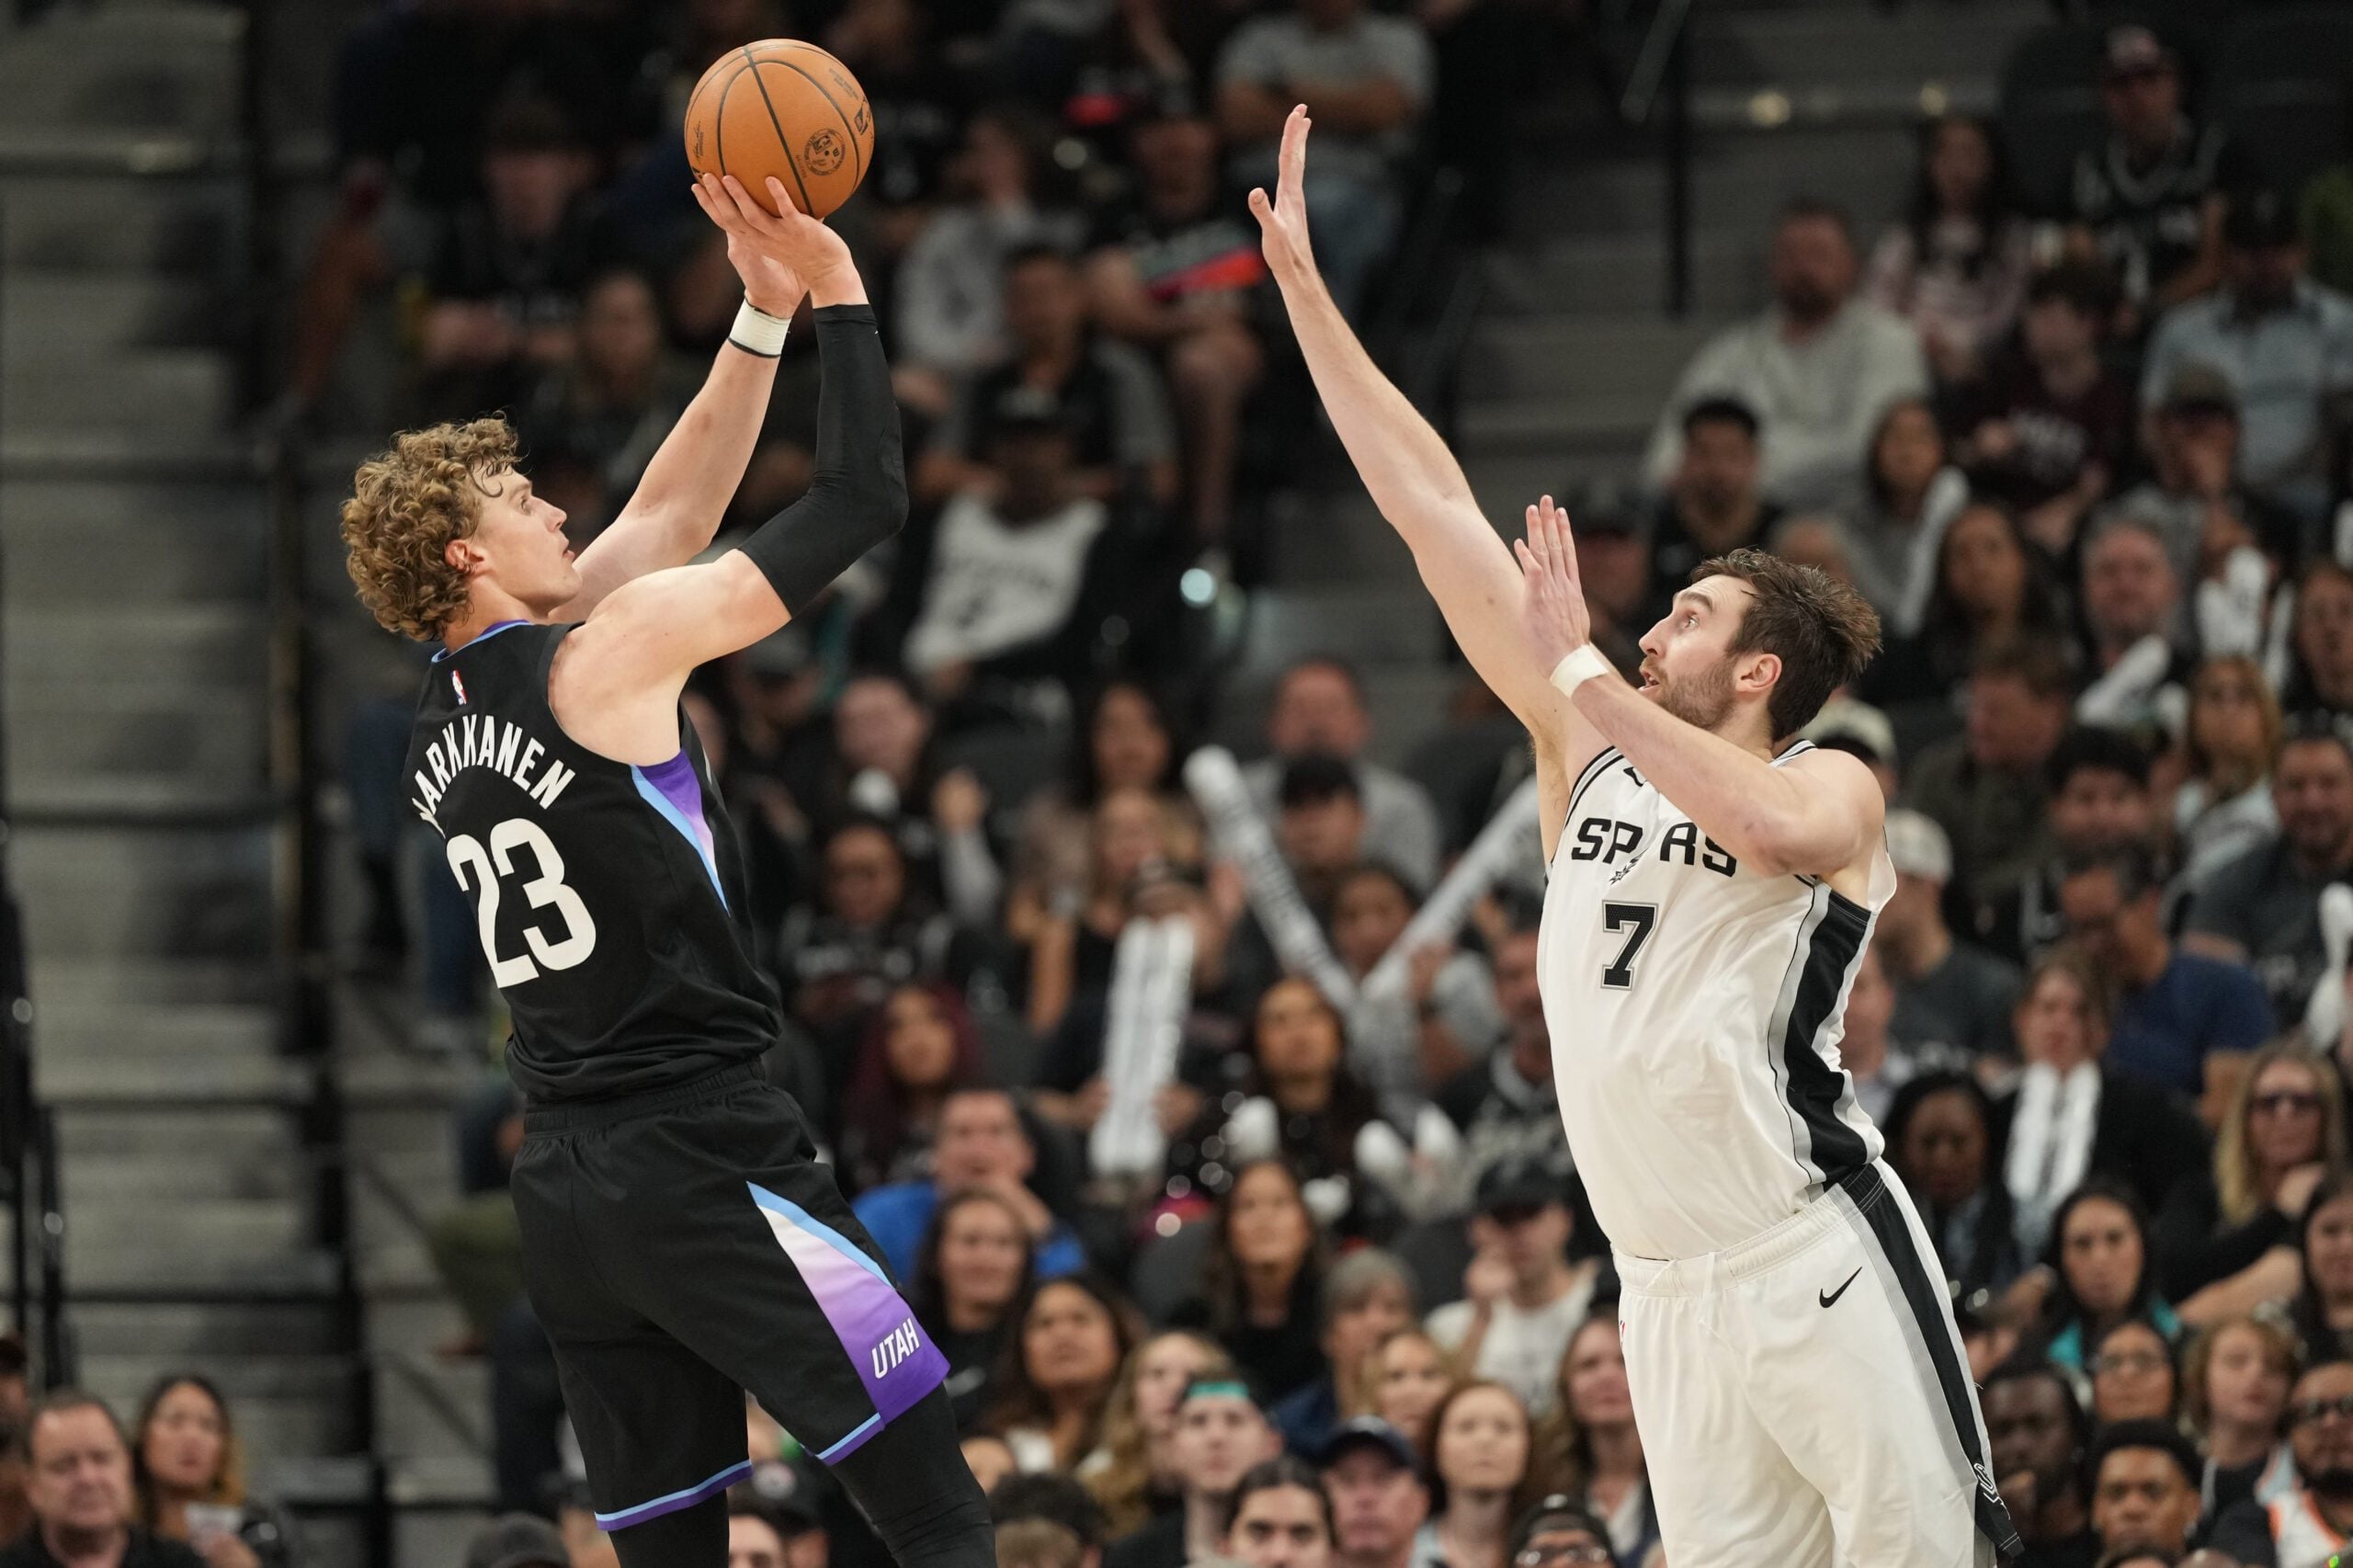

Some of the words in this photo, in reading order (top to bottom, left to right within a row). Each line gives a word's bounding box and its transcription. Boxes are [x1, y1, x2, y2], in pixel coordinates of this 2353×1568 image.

[447, 817, 597, 988] 23
[1600, 899, 1659, 991] 7
[871, 1317, 920, 1379] UTAH
